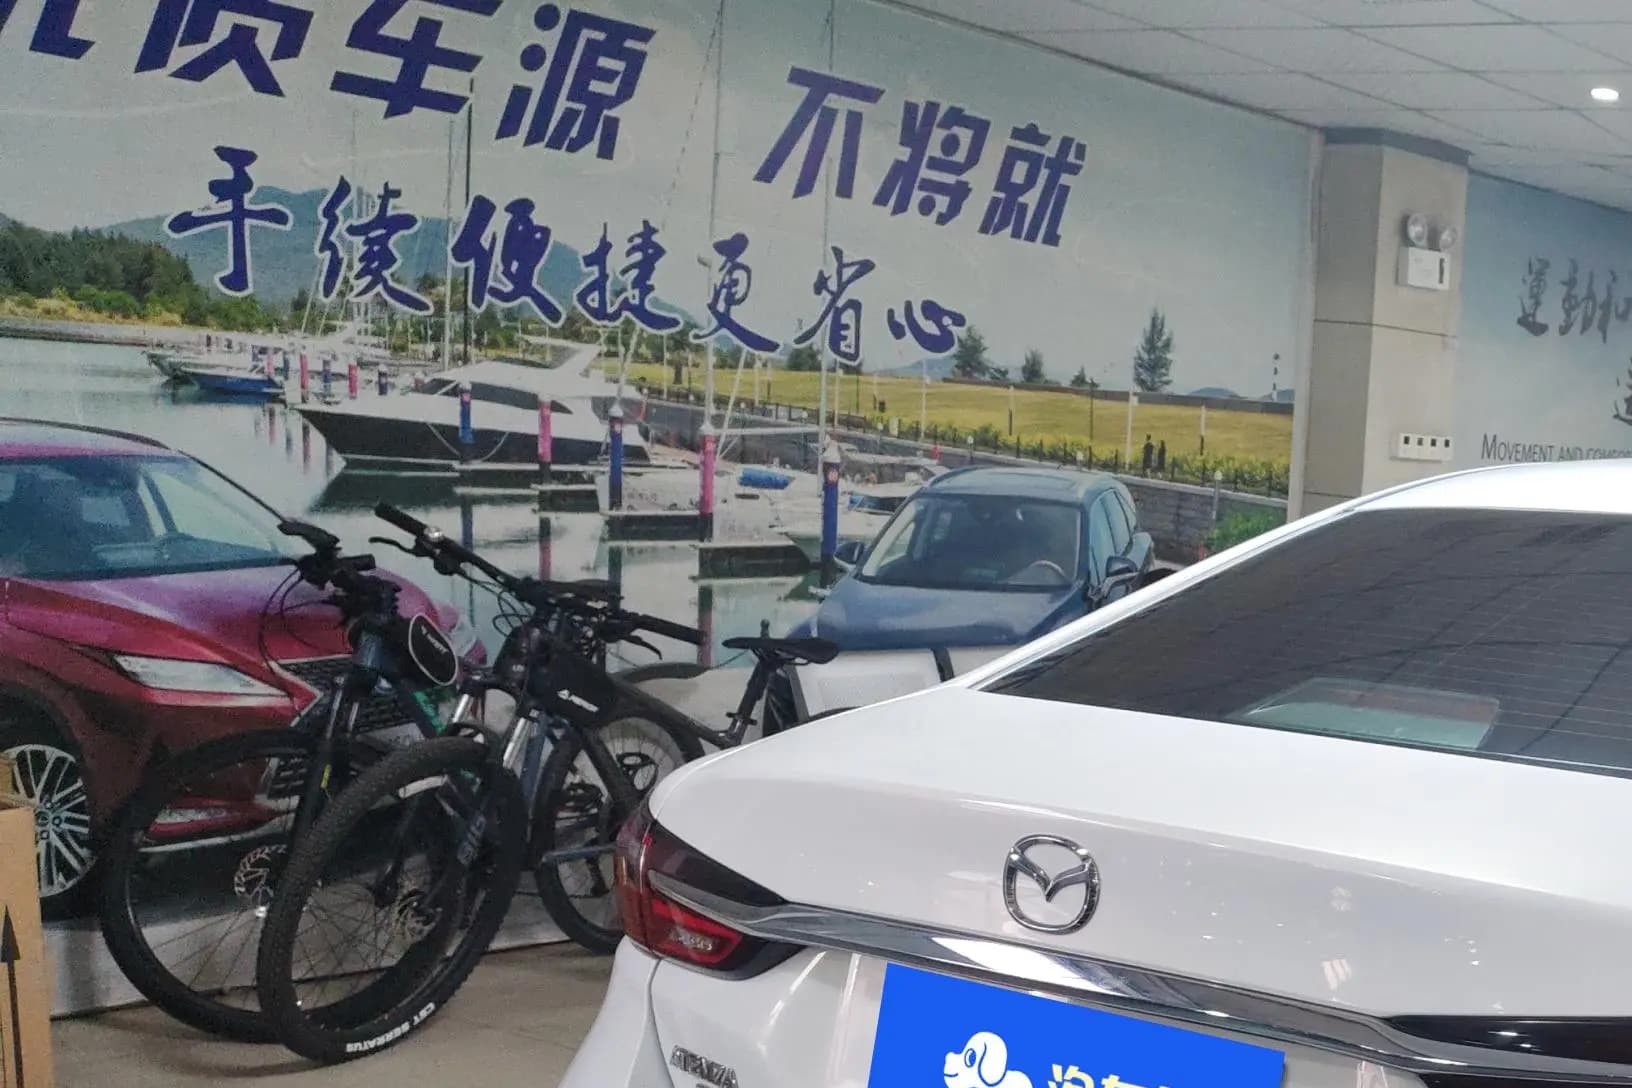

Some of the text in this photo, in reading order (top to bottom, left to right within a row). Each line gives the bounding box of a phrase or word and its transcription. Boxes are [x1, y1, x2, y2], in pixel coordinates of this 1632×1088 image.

[167, 144, 967, 363] 手续便捷更省心
[753, 65, 1087, 247] 不将就
